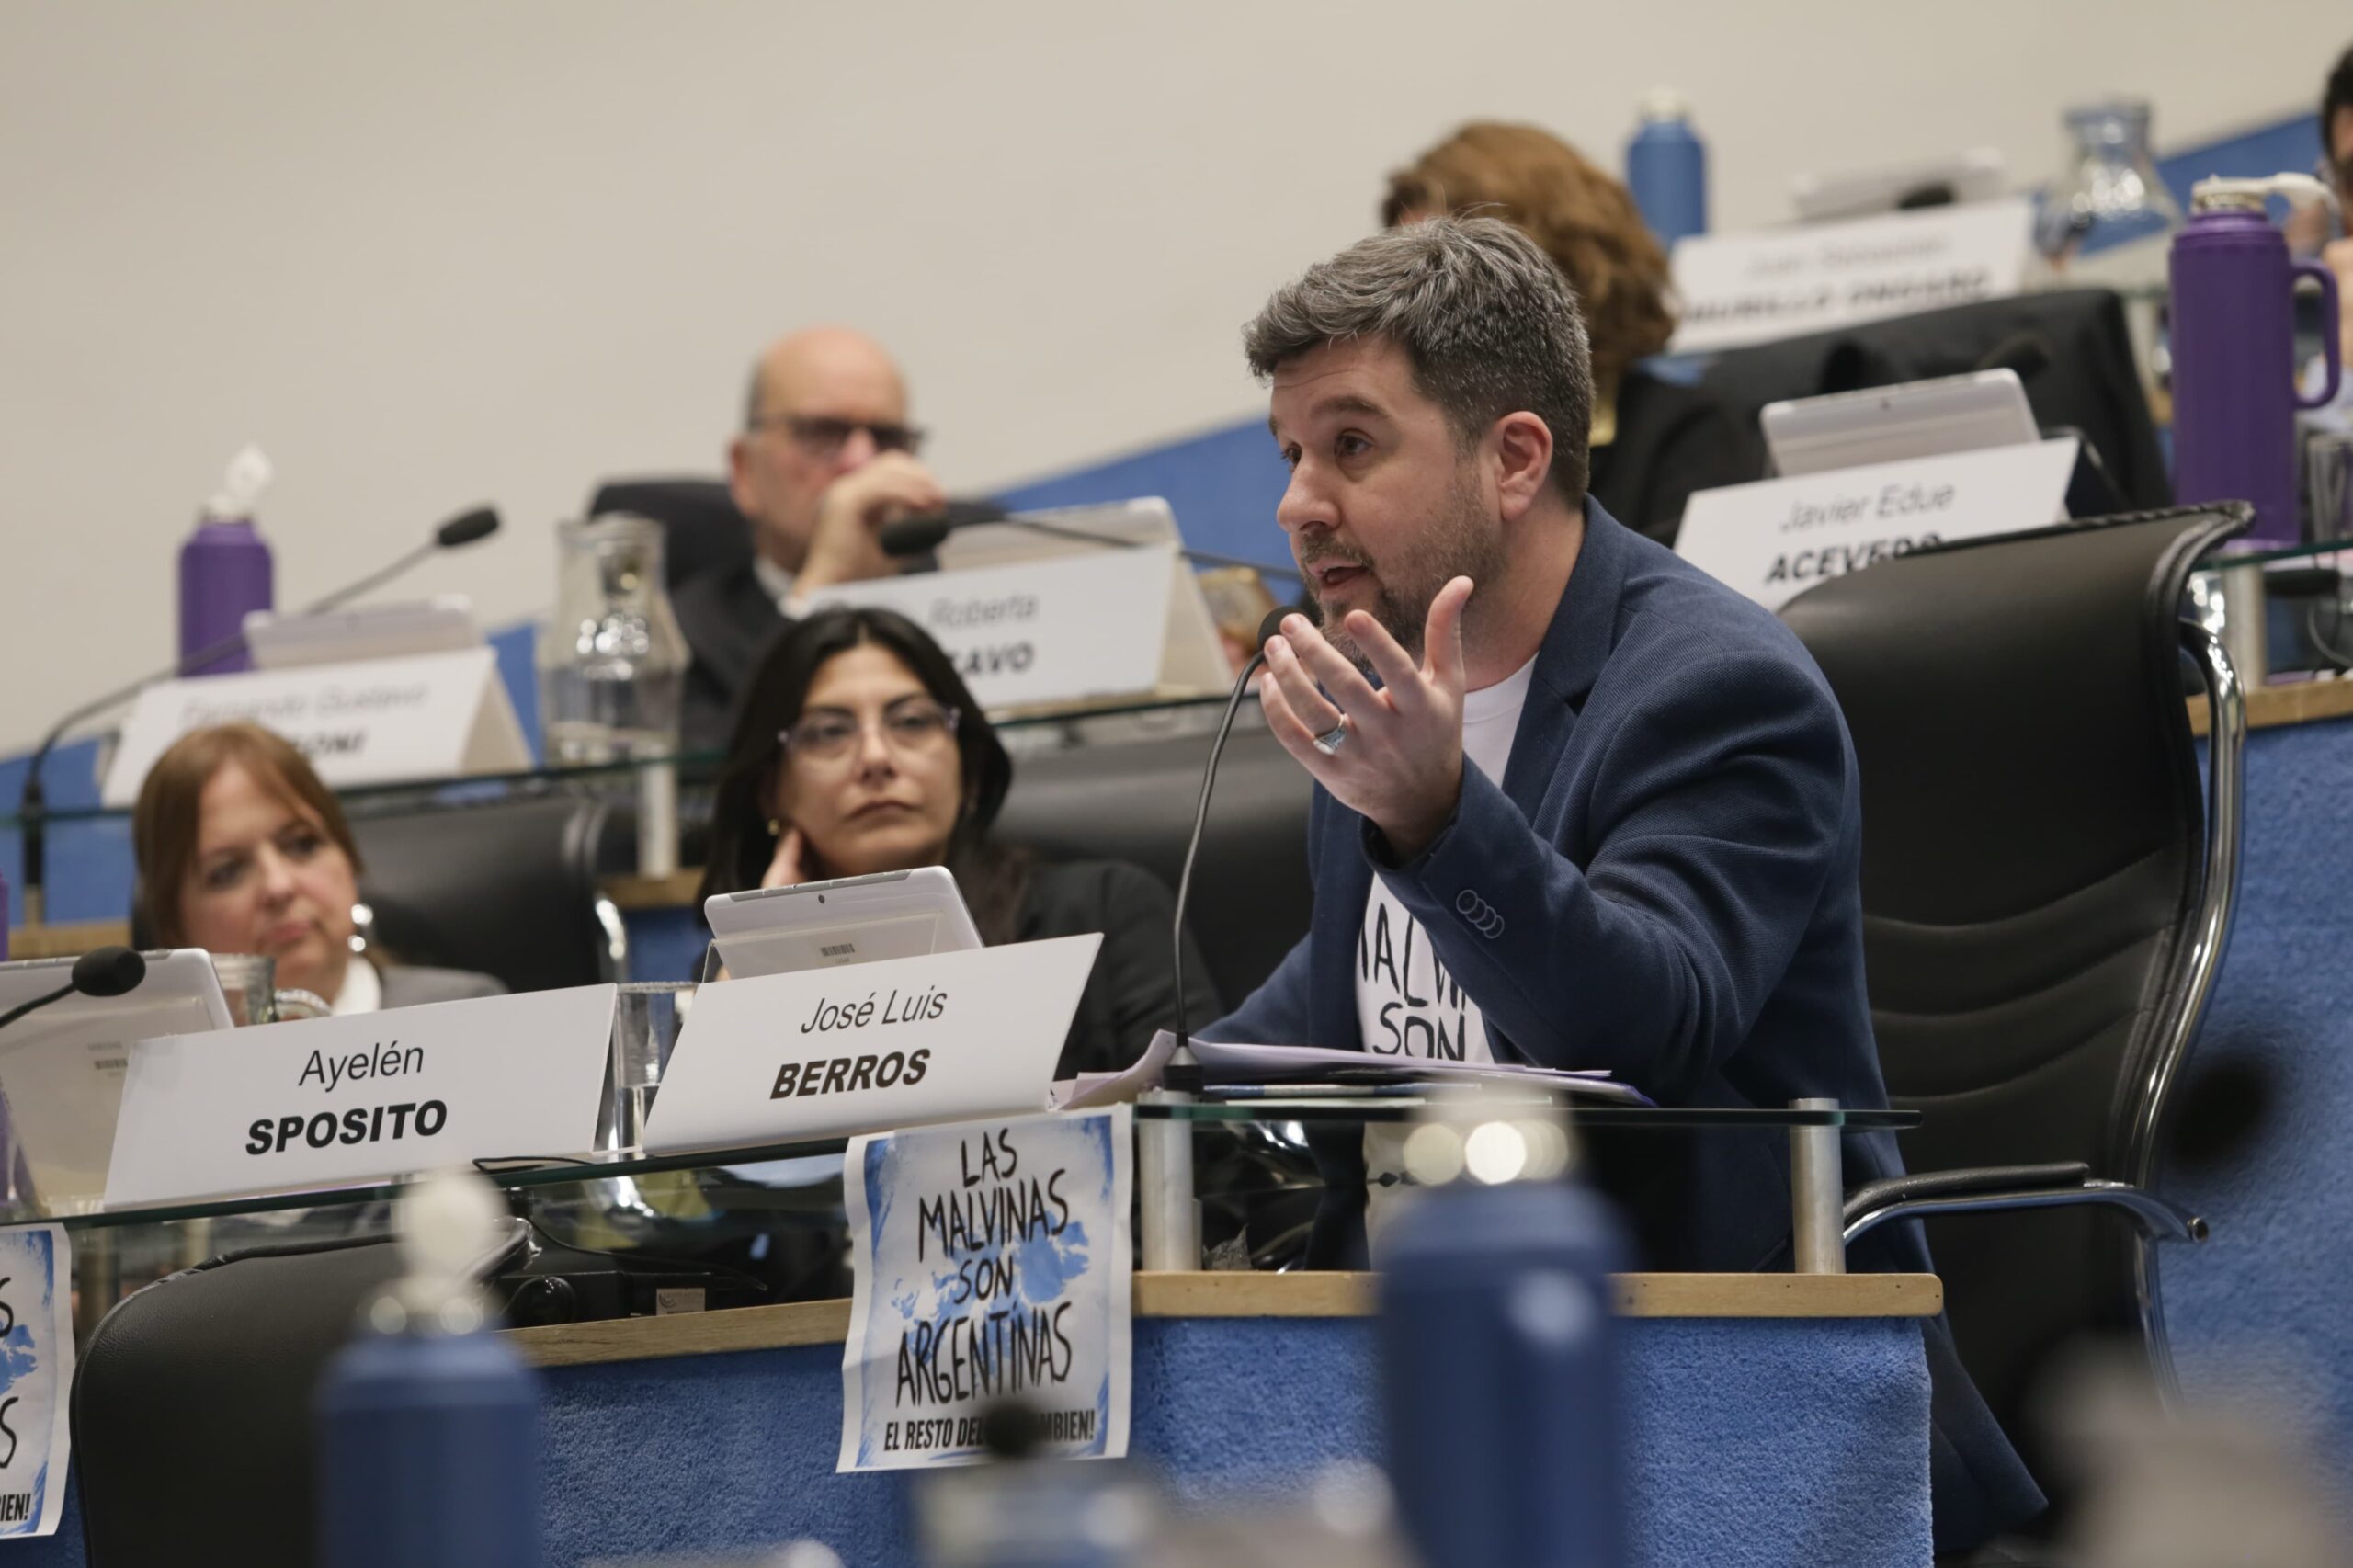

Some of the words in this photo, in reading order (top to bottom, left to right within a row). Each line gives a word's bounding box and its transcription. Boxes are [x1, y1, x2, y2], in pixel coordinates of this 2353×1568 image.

[1779, 494, 1870, 533] Javier
[953, 642, 1035, 674] AVO
[801, 992, 876, 1034] José
[881, 985, 948, 1025] Luis
[1372, 1002, 1466, 1062] SON
[298, 1040, 425, 1093] Ayelén
[769, 1049, 931, 1100] BERROS
[245, 1099, 448, 1155] SPOSITO
[961, 1128, 1017, 1187] LAS
[919, 1168, 1068, 1263] MALVINAS
[953, 1255, 1014, 1304] SON
[884, 1422, 900, 1451] EL
[904, 1418, 953, 1449] RESTO
[956, 1416, 984, 1447] DEL
[1038, 1408, 1095, 1442] MBIEN!
[0, 1494, 31, 1521] IEN!
